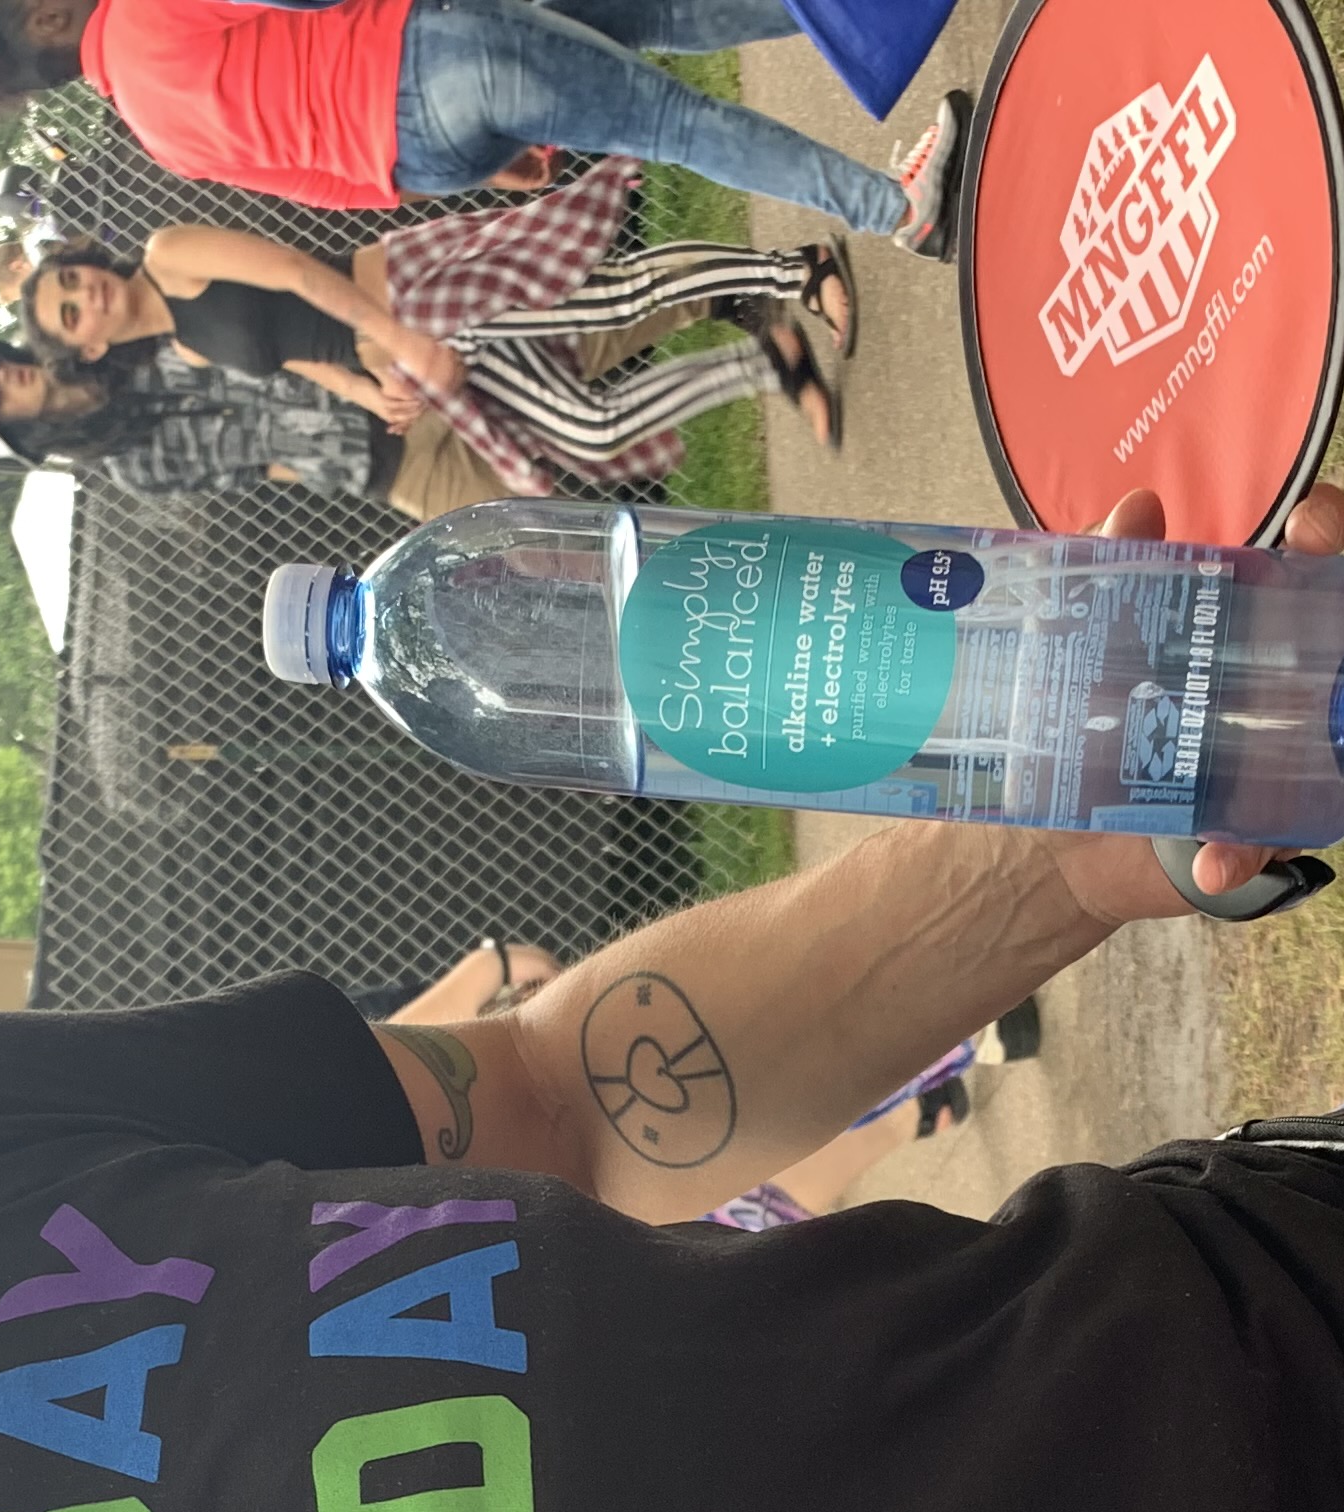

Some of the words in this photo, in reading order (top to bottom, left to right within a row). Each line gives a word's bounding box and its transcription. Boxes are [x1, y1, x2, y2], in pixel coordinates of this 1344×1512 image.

[1044, 79, 1229, 365] MNGFFL
[1111, 233, 1276, 463] www.mngffl.com
[797, 551, 825, 625] water
[860, 572, 881, 608] with
[929, 579, 951, 606] pH
[1195, 588, 1221, 602] 1L
[1191, 604, 1221, 626] OZ)
[658, 541, 741, 733] Simply
[816, 561, 856, 724] electrolytes
[856, 613, 875, 663] water
[901, 621, 918, 665] taste
[1190, 628, 1214, 644] FL
[872, 605, 898, 709] electrolytes
[1187, 647, 1213, 669] 1.8
[782, 633, 813, 753] alkaline
[896, 670, 913, 696] for
[1184, 671, 1211, 706] (1QT
[849, 670, 869, 740] purified
[1180, 708, 1206, 728] OZ
[820, 732, 837, 747] +
[1177, 732, 1203, 748] FL
[1173, 750, 1200, 778] 33.8
